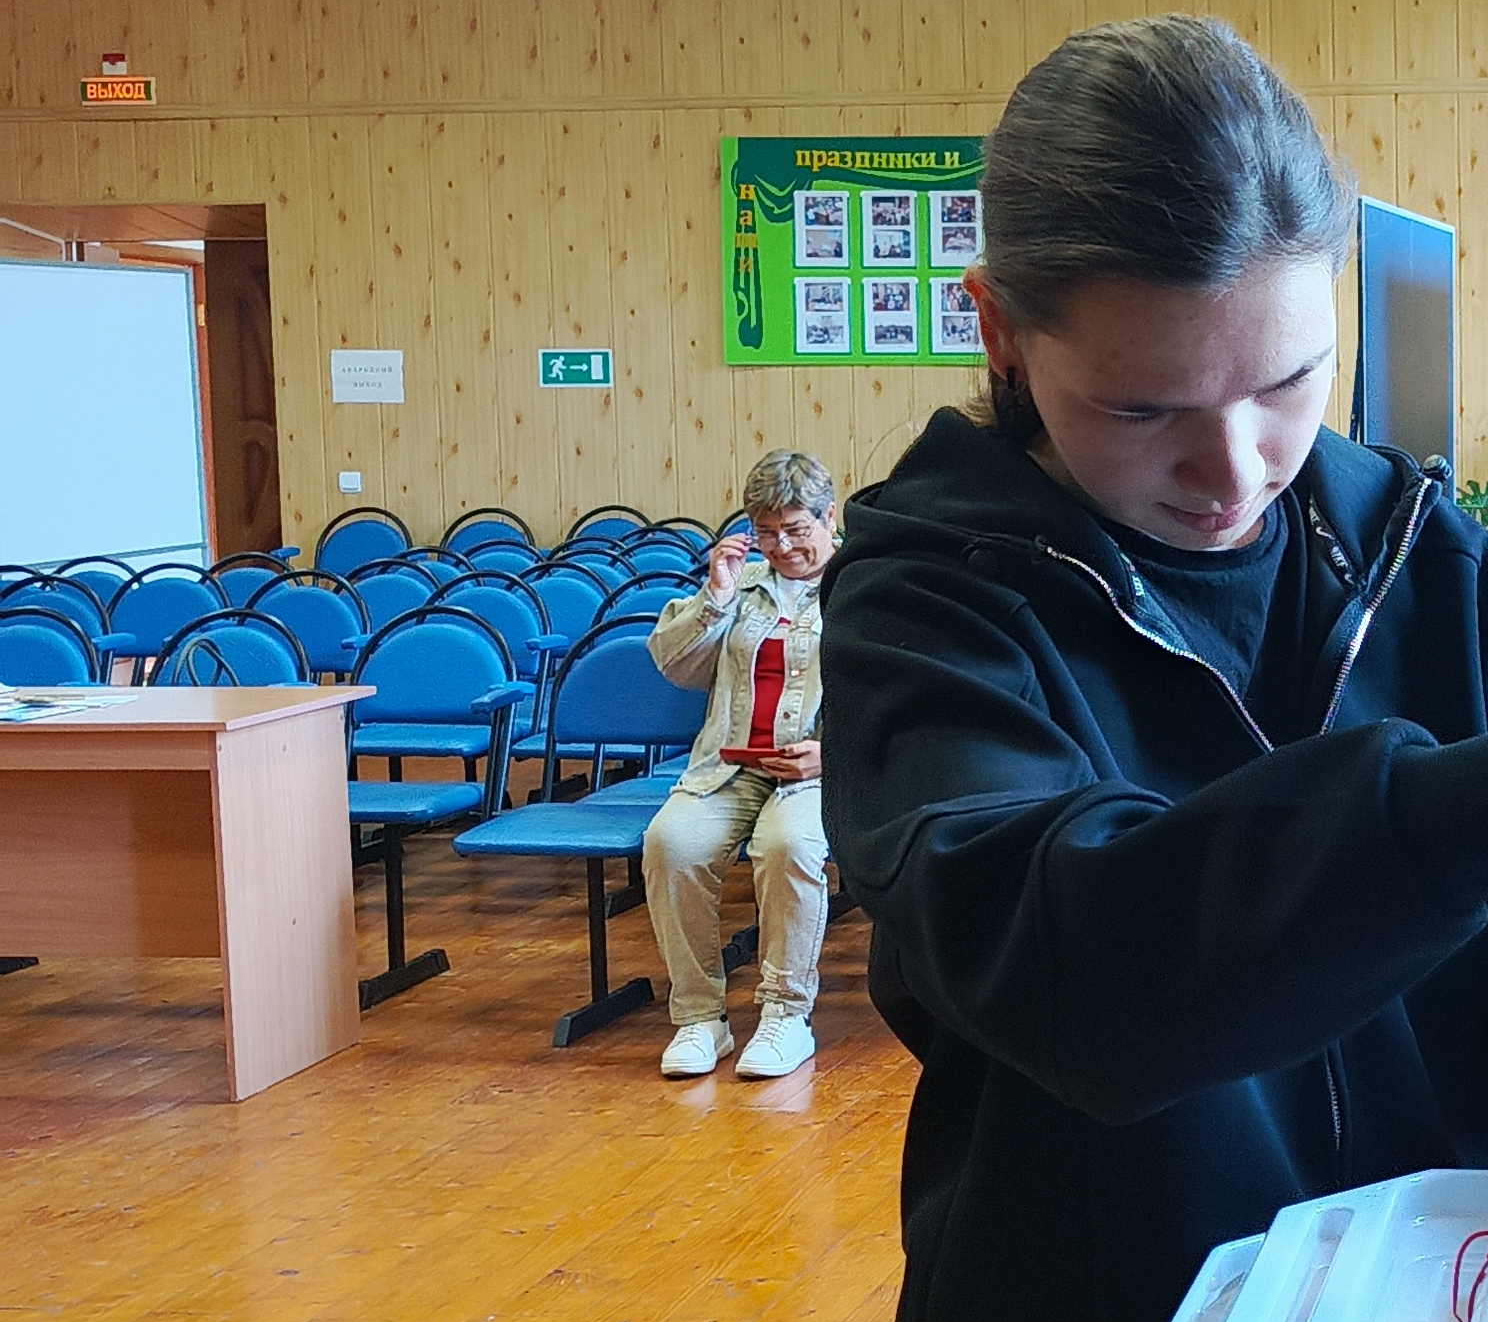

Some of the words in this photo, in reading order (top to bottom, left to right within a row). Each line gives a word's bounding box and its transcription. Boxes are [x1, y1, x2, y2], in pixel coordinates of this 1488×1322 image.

[86, 83, 146, 99] ВЫХОД
[795, 149, 936, 171] праздники
[944, 151, 961, 168] и
[735, 184, 758, 272] наши
